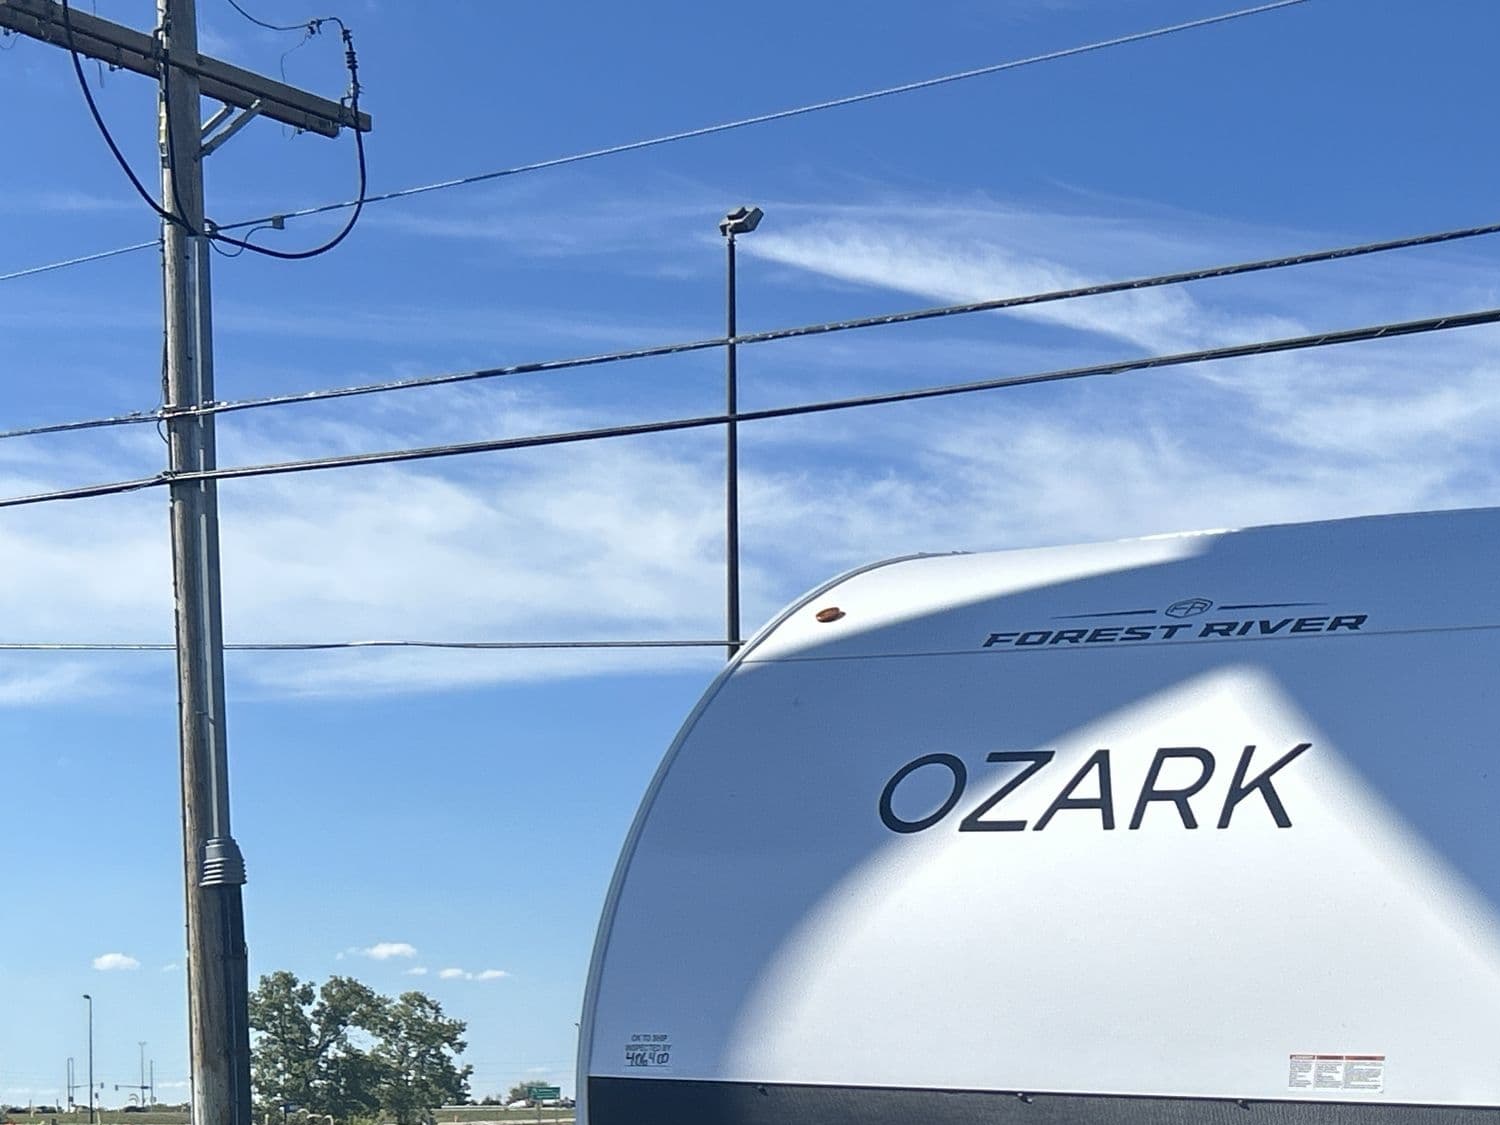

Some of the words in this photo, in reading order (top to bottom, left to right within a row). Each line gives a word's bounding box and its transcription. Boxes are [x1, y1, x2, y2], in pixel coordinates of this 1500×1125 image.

[982, 623, 1192, 649] FOREST
[1198, 614, 1369, 639] RIVER
[879, 743, 1313, 834] OZARK
